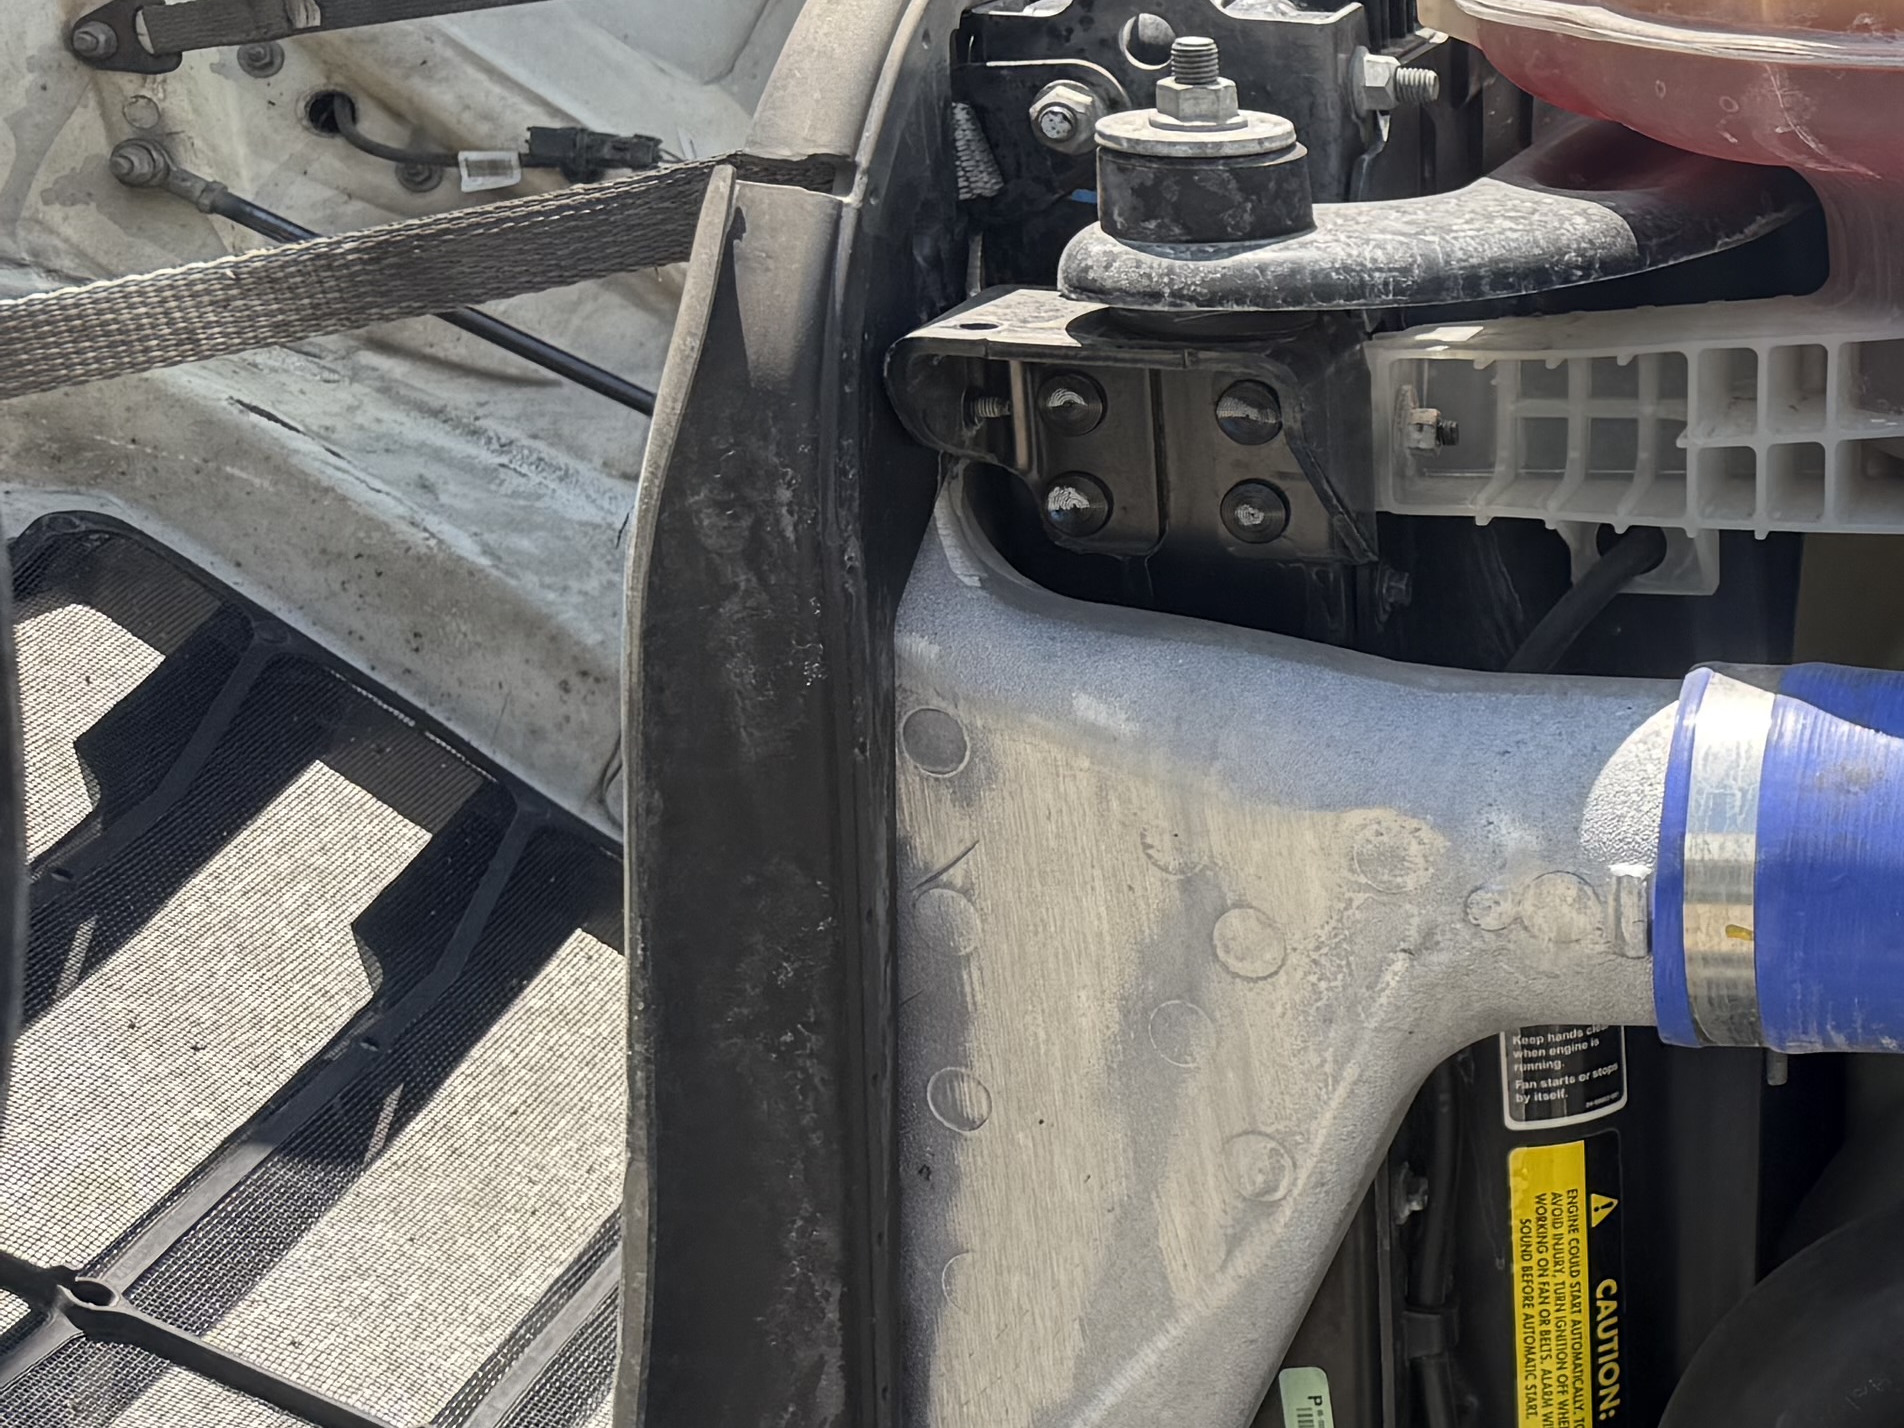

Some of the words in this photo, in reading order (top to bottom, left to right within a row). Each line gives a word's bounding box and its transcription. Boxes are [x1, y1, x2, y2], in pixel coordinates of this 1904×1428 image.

[1512, 1035, 1544, 1046] Keep
[1547, 1028, 1584, 1042] hands
[1513, 1049, 1546, 1058] when
[1549, 1041, 1588, 1056] engine
[1591, 1037, 1599, 1047] is
[1514, 1059, 1565, 1072] running.
[1515, 1079, 1537, 1090] Fan
[1540, 1075, 1576, 1088] starts
[1578, 1072, 1590, 1082] or
[1592, 1062, 1619, 1079] stops
[1516, 1093, 1531, 1104] by
[1534, 1088, 1568, 1102] itself.
[1535, 1192, 1549, 1254] WORKING
[1551, 1192, 1563, 1230] AVOID
[1567, 1188, 1579, 1234] ENGINE
[1520, 1218, 1533, 1262] SOUND
[1552, 1233, 1566, 1278] INJURY,
[1537, 1257, 1549, 1278] ON
[1568, 1238, 1581, 1278] COULD
[1521, 1266, 1535, 1309] BEFORE
[1538, 1281, 1550, 1305] FAN
[1554, 1281, 1566, 1312] TURN
[1570, 1281, 1582, 1314] START
[1539, 1309, 1551, 1327] OR
[1523, 1313, 1537, 1381] AUTOMATIC
[1540, 1329, 1552, 1364] BELTS.
[1555, 1315, 1569, 1371] IGNITION
[1596, 1278, 1621, 1421] CAUTION:
[1557, 1374, 1569, 1395] OFF
[1570, 1319, 1585, 1415] AUTOMATICALLY.
[1307, 1394, 1323, 1406] P
[1525, 1384, 1538, 1419] START.
[1541, 1368, 1554, 1409] ALARM
